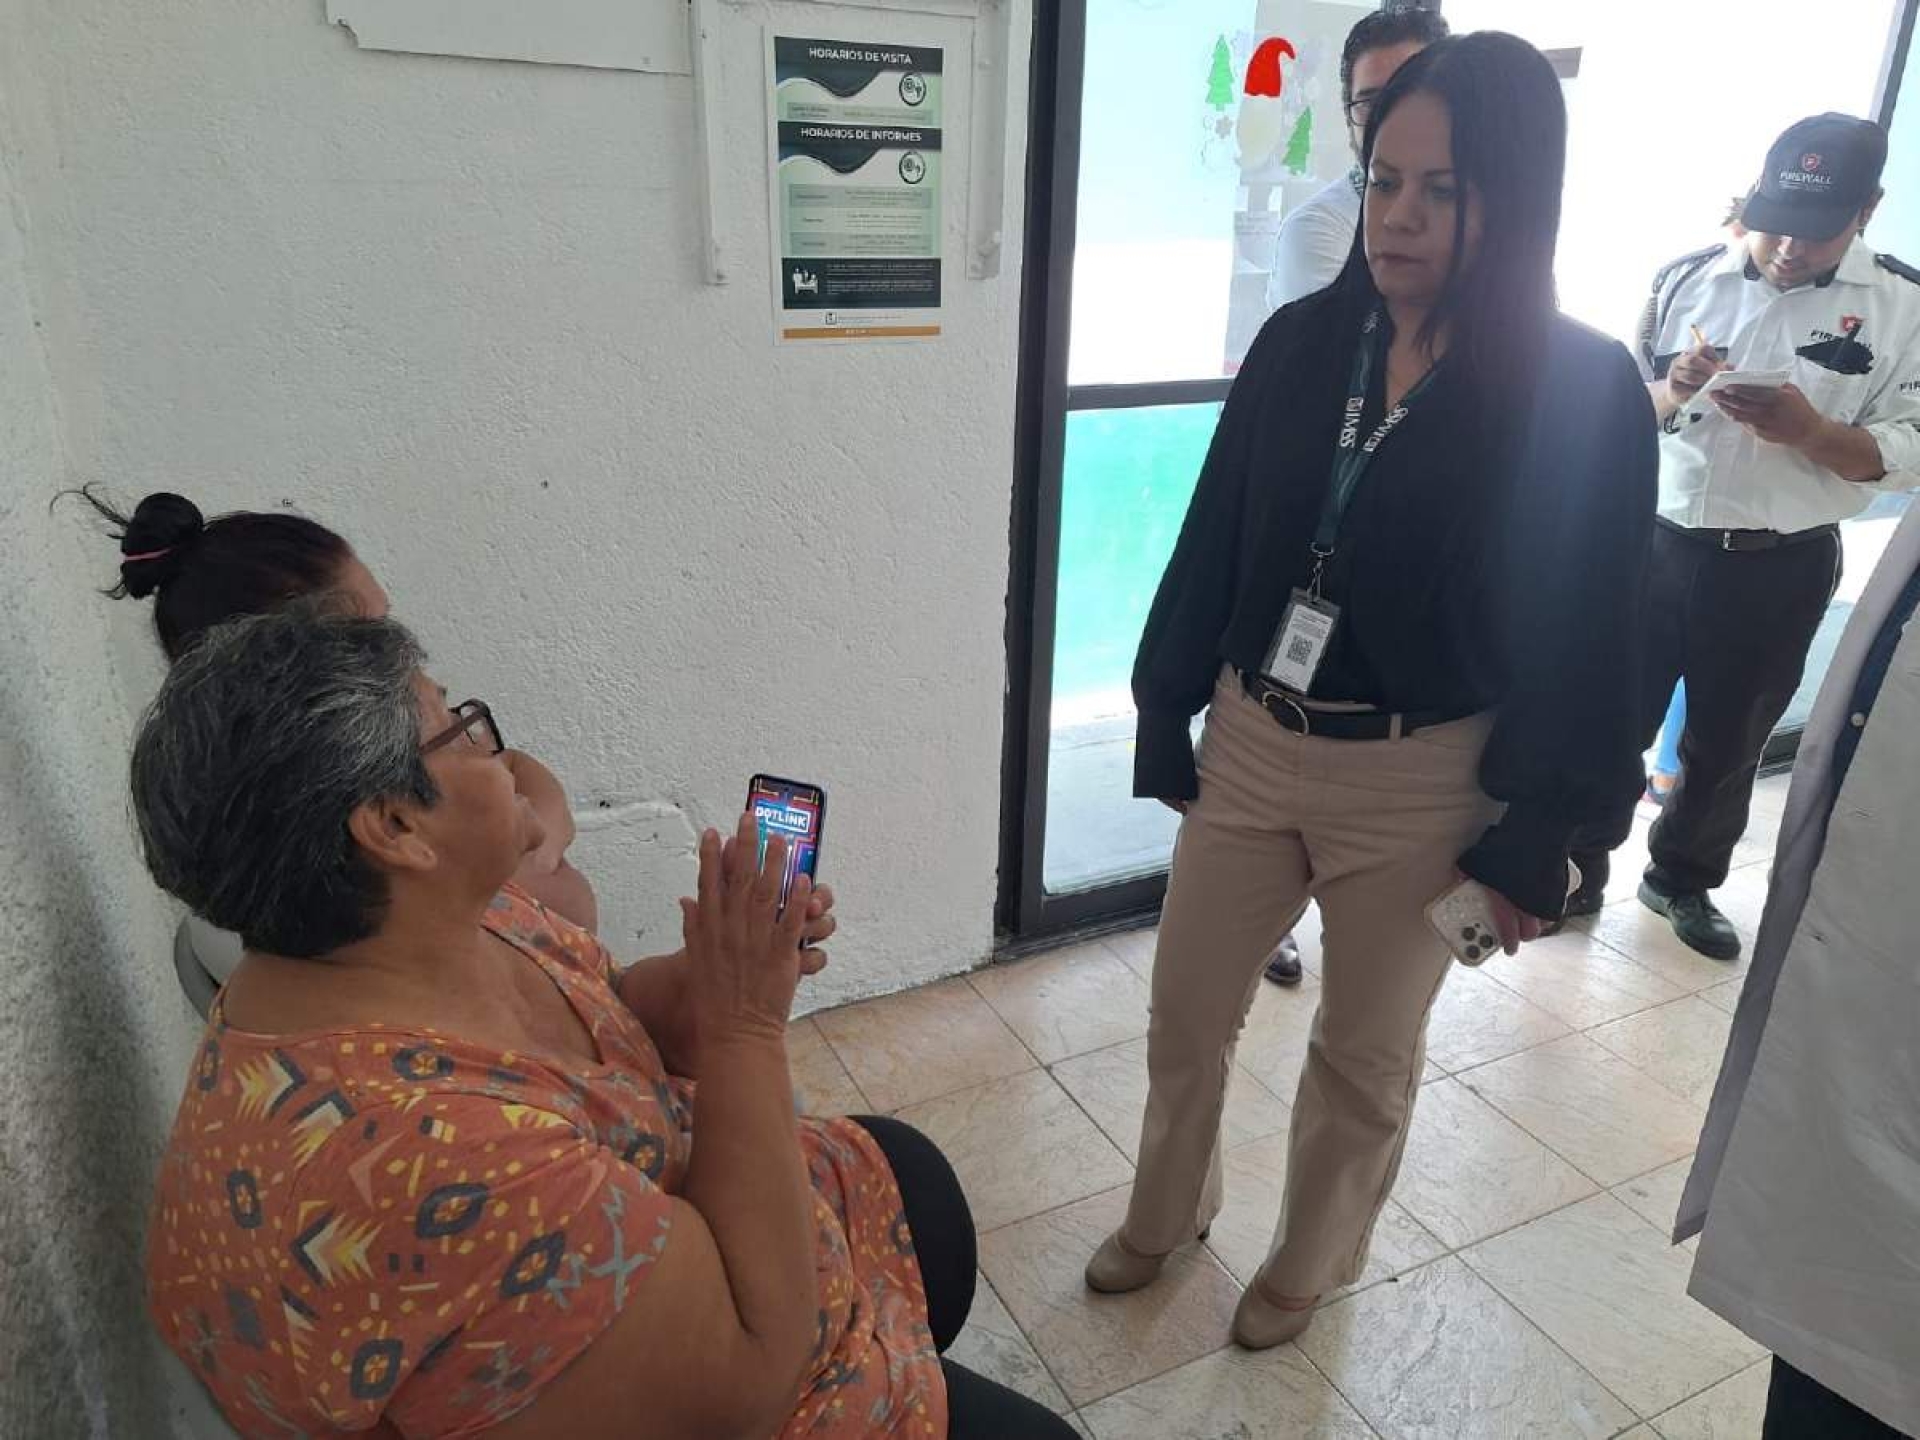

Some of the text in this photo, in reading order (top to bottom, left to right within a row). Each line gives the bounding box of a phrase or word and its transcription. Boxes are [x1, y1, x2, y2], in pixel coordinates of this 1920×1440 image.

[809, 48, 912, 64] HORARIOS DE VISITA
[801, 128, 922, 142] HORARIOS DE INFORMES
[1780, 172, 1831, 184] FIREWALL
[1340, 413, 1361, 448] IMSS
[755, 806, 807, 827] DOTLINK
